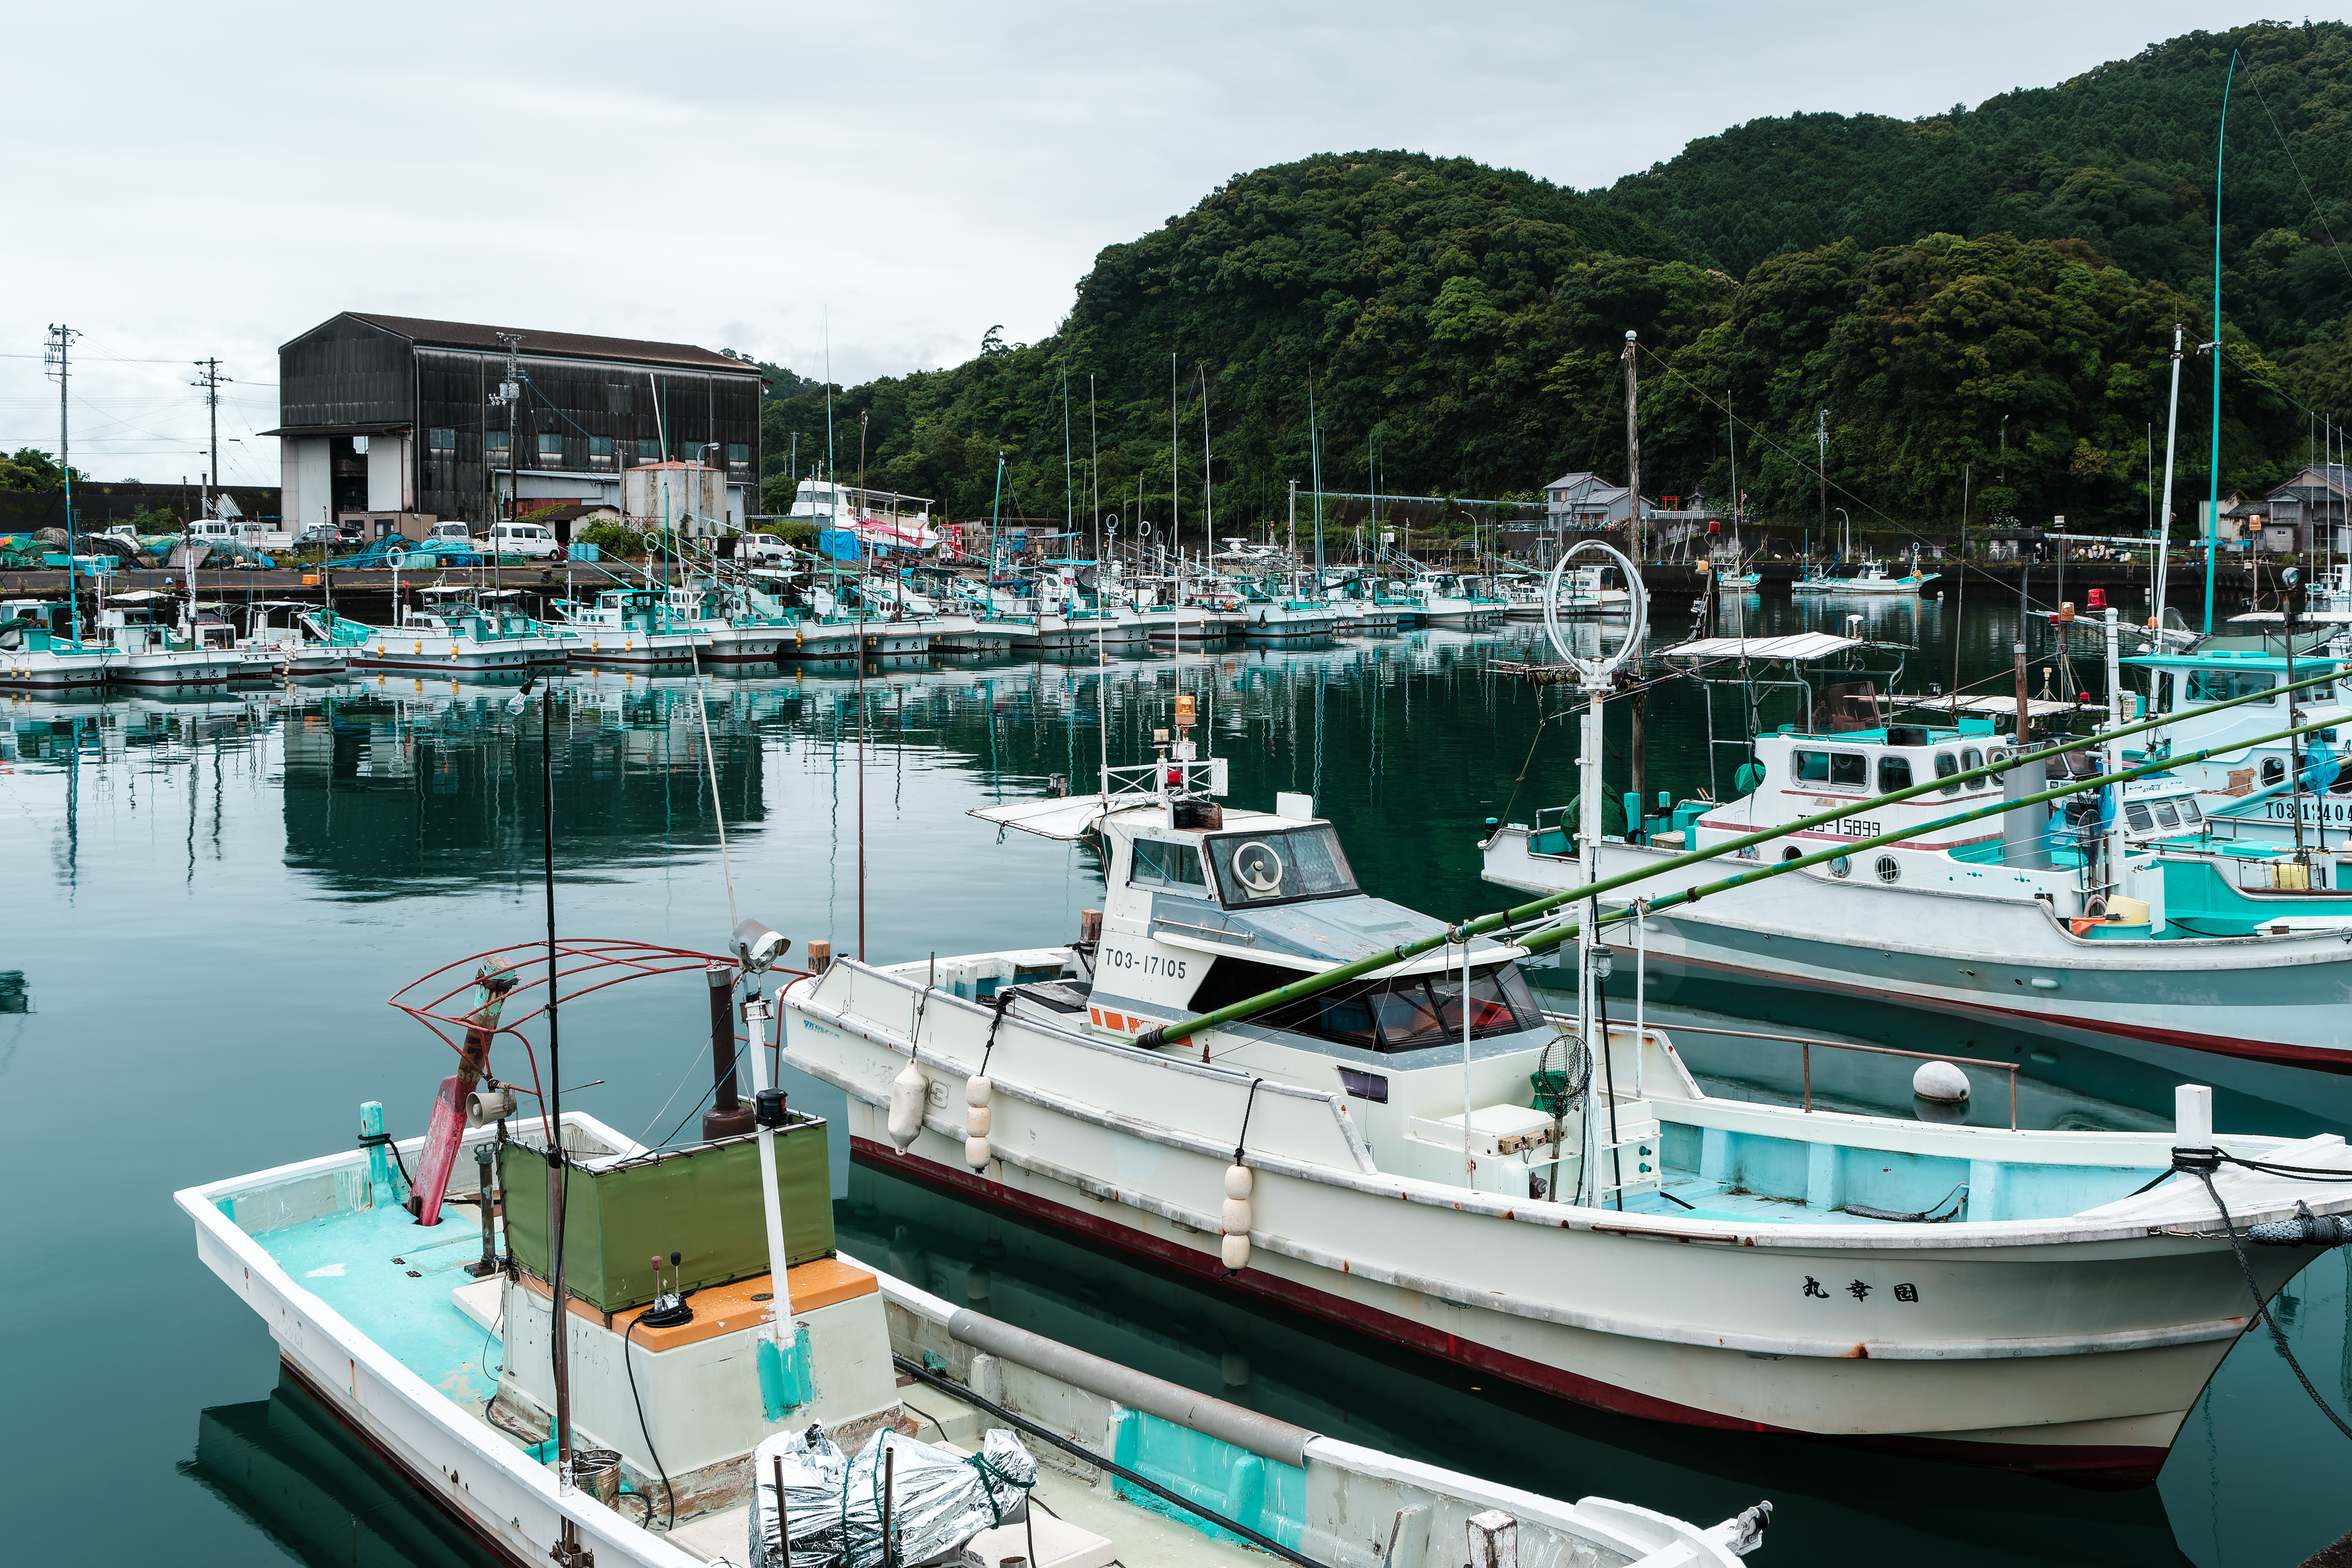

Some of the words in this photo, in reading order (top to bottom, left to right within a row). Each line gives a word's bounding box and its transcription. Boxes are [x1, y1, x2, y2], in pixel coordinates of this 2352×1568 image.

[63, 671, 98, 681] 太一丸
[1106, 948, 1187, 979] TO3-17105
